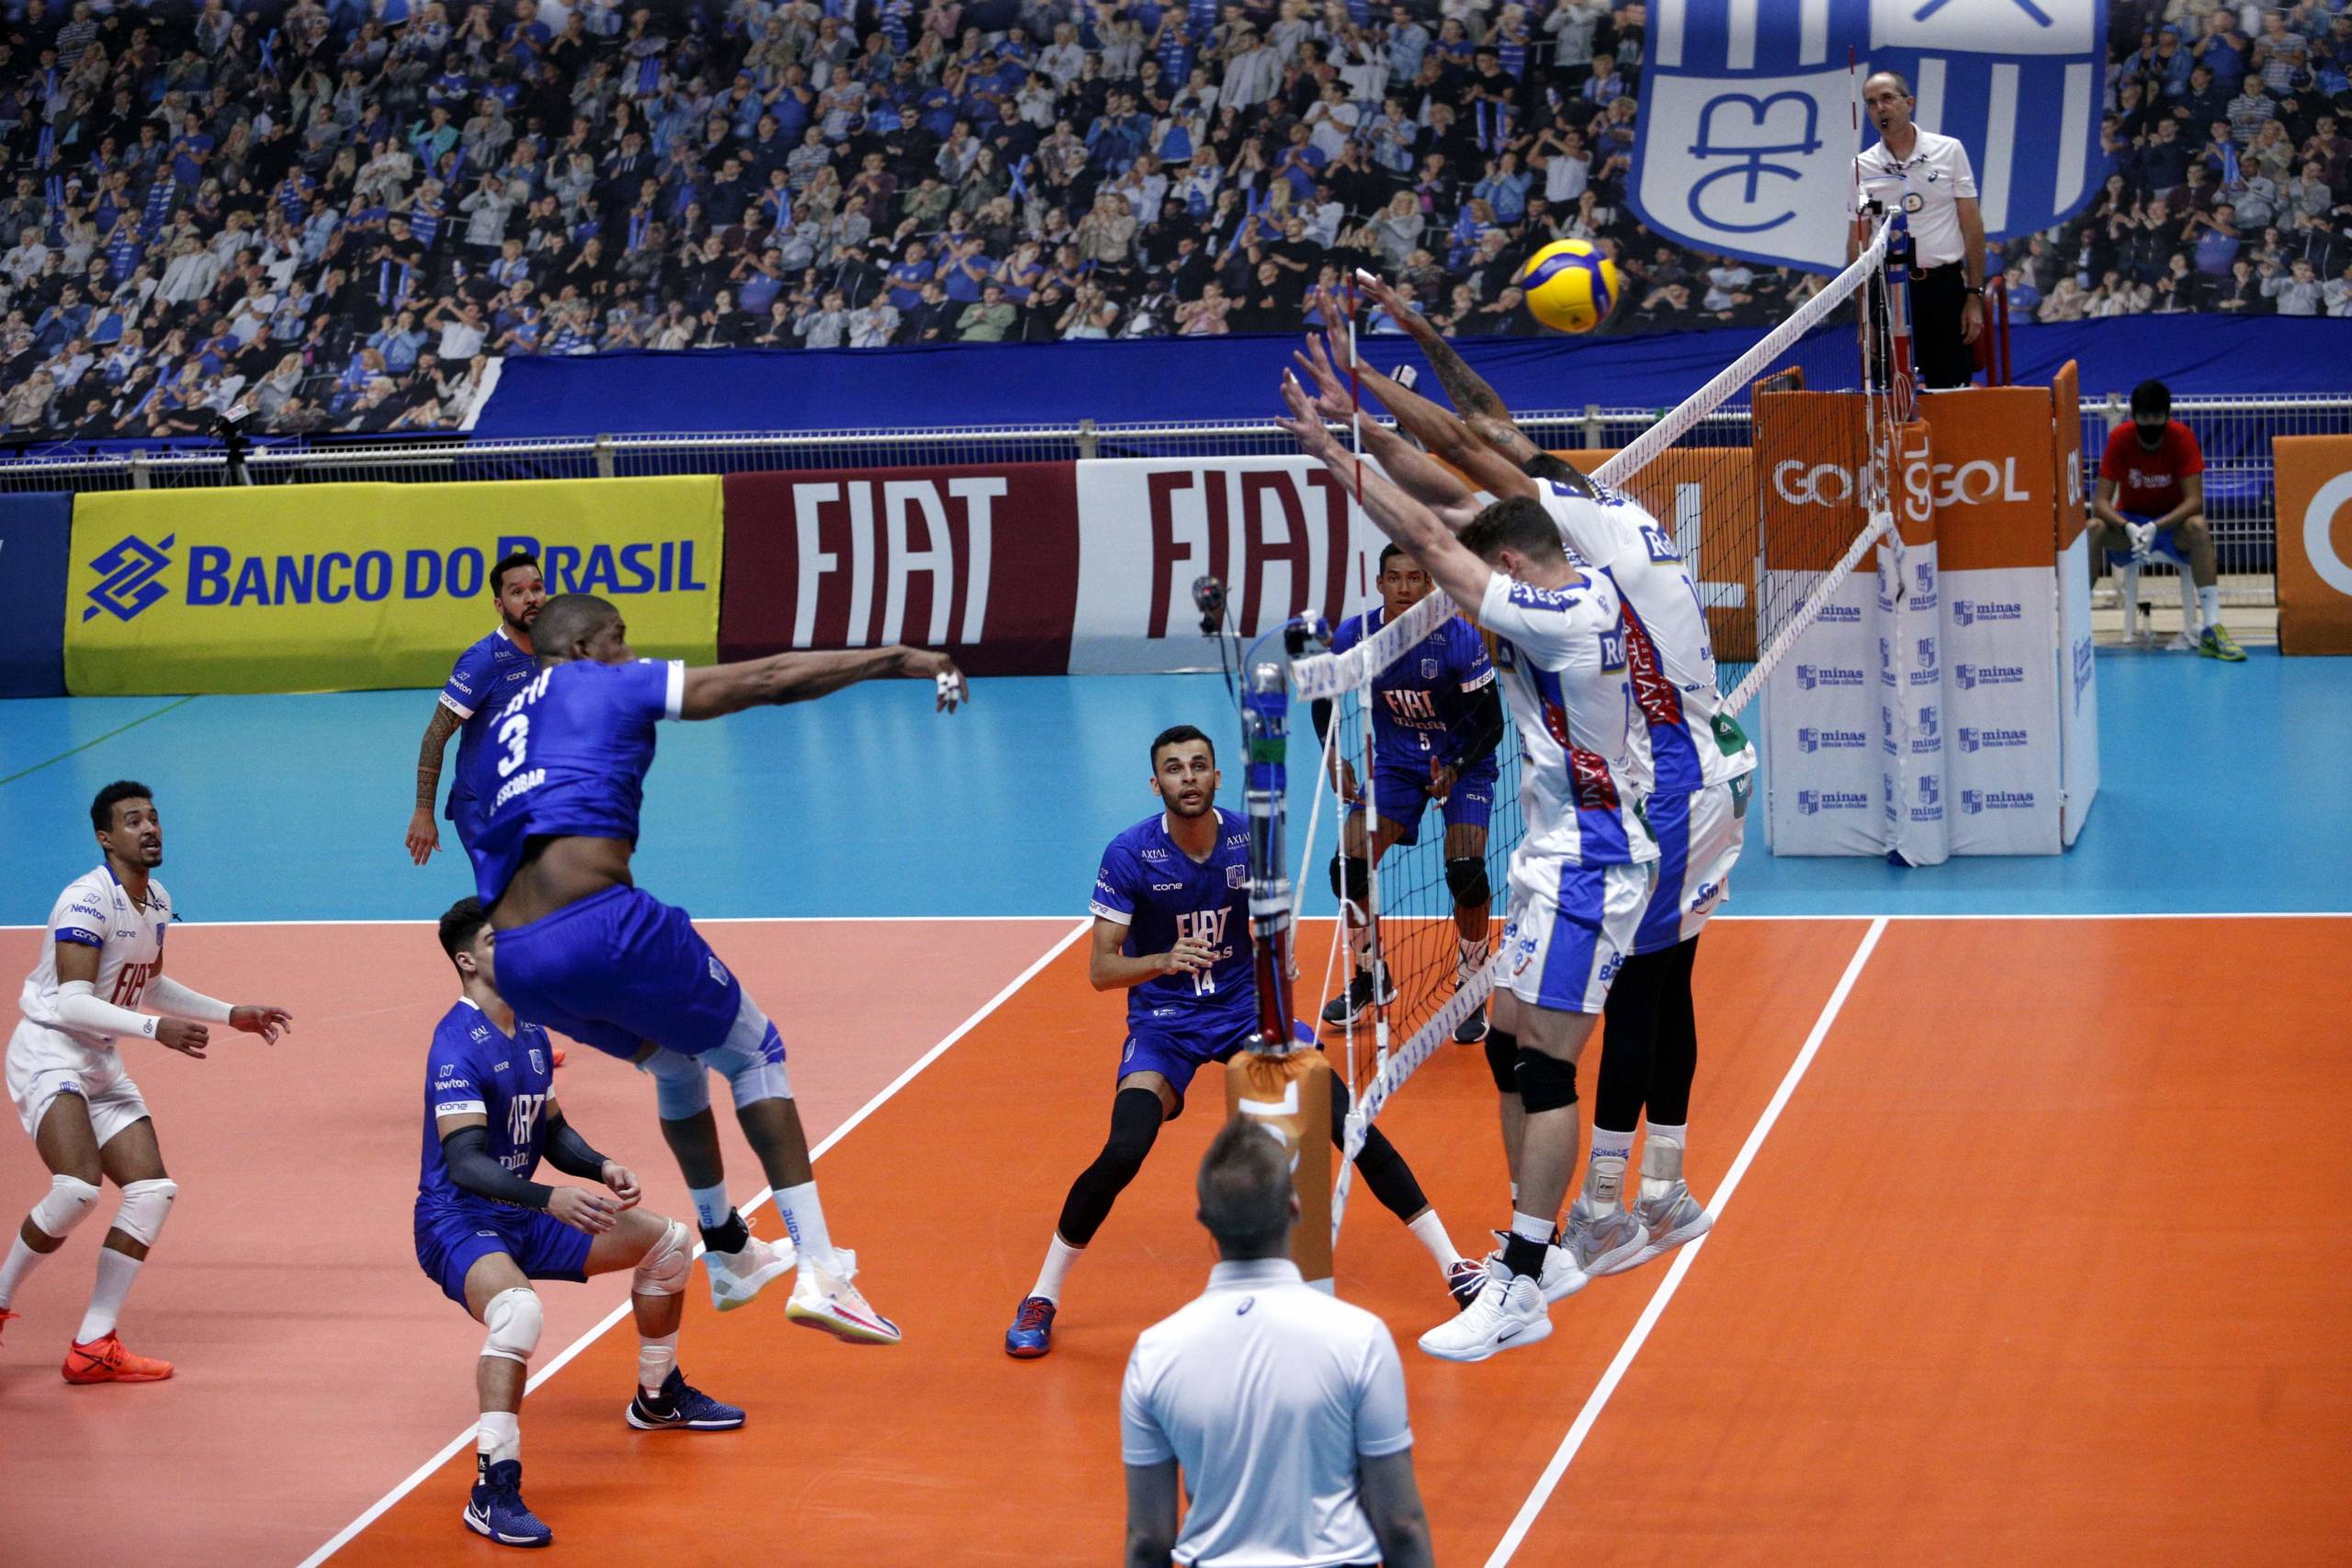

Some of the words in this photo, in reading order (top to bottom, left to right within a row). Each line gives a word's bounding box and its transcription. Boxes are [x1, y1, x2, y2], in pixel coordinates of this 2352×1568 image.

[792, 477, 1008, 648] FIAT
[186, 546, 392, 606] BANCO
[403, 547, 484, 600] DO
[1976, 602, 2021, 614] minas
[1819, 667, 1863, 679] minas
[1978, 665, 2023, 677] minas
[1382, 690, 1435, 718] FIAT
[1821, 729, 1866, 740] minas
[1982, 728, 2027, 740] minas
[498, 714, 529, 778] 3
[1419, 732, 1430, 751] 5
[1822, 791, 1867, 802] minas
[1985, 791, 2034, 802] minas
[1227, 831, 1250, 846] AXIA
[1141, 848, 1169, 859] AXIAL
[71, 904, 106, 924] Newton
[1176, 906, 1232, 950] FIAT
